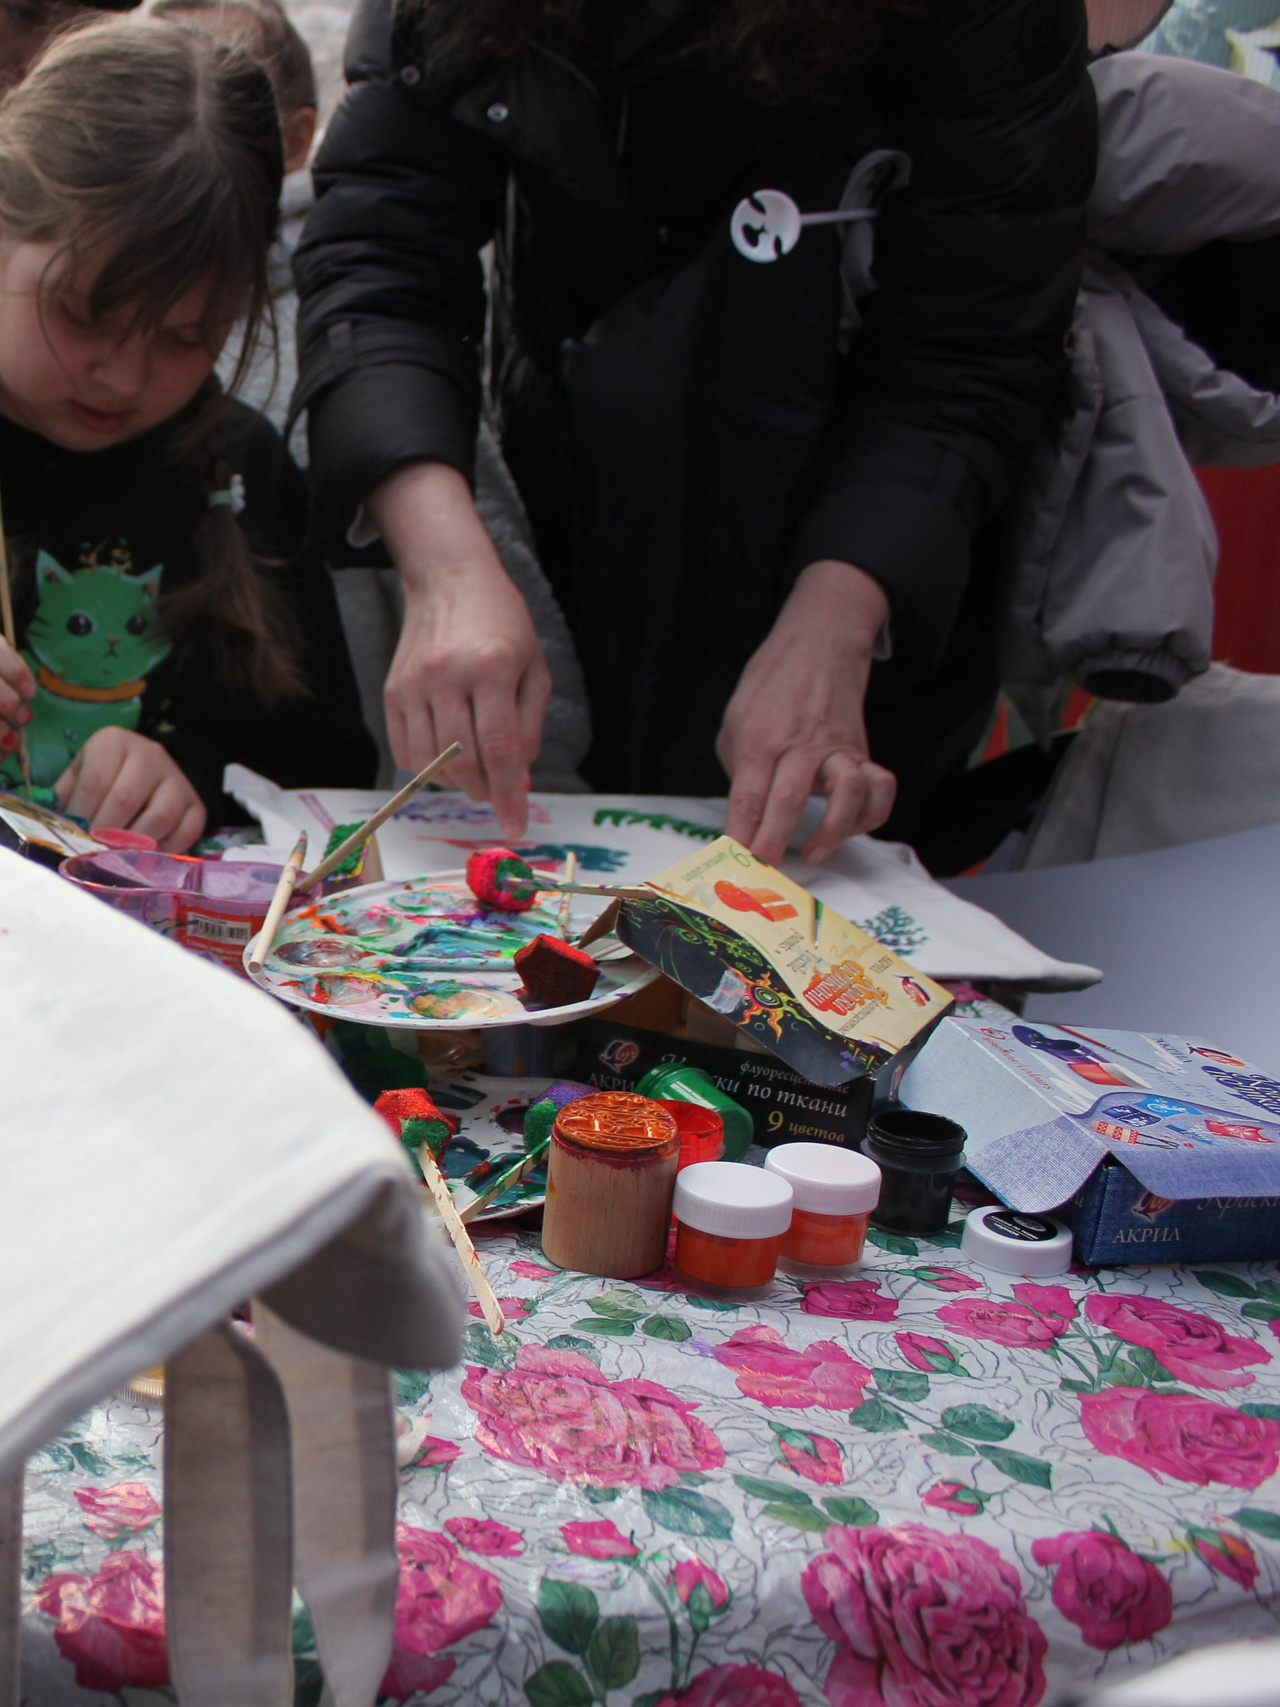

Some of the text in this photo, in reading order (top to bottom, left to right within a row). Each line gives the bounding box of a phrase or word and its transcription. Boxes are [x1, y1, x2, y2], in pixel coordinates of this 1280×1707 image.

[587, 1072, 636, 1094] АКРИ
[747, 1083, 848, 1118] по ткани
[766, 1110, 845, 1143] 9 цветов
[1112, 1228, 1181, 1244] АКРИЛ
